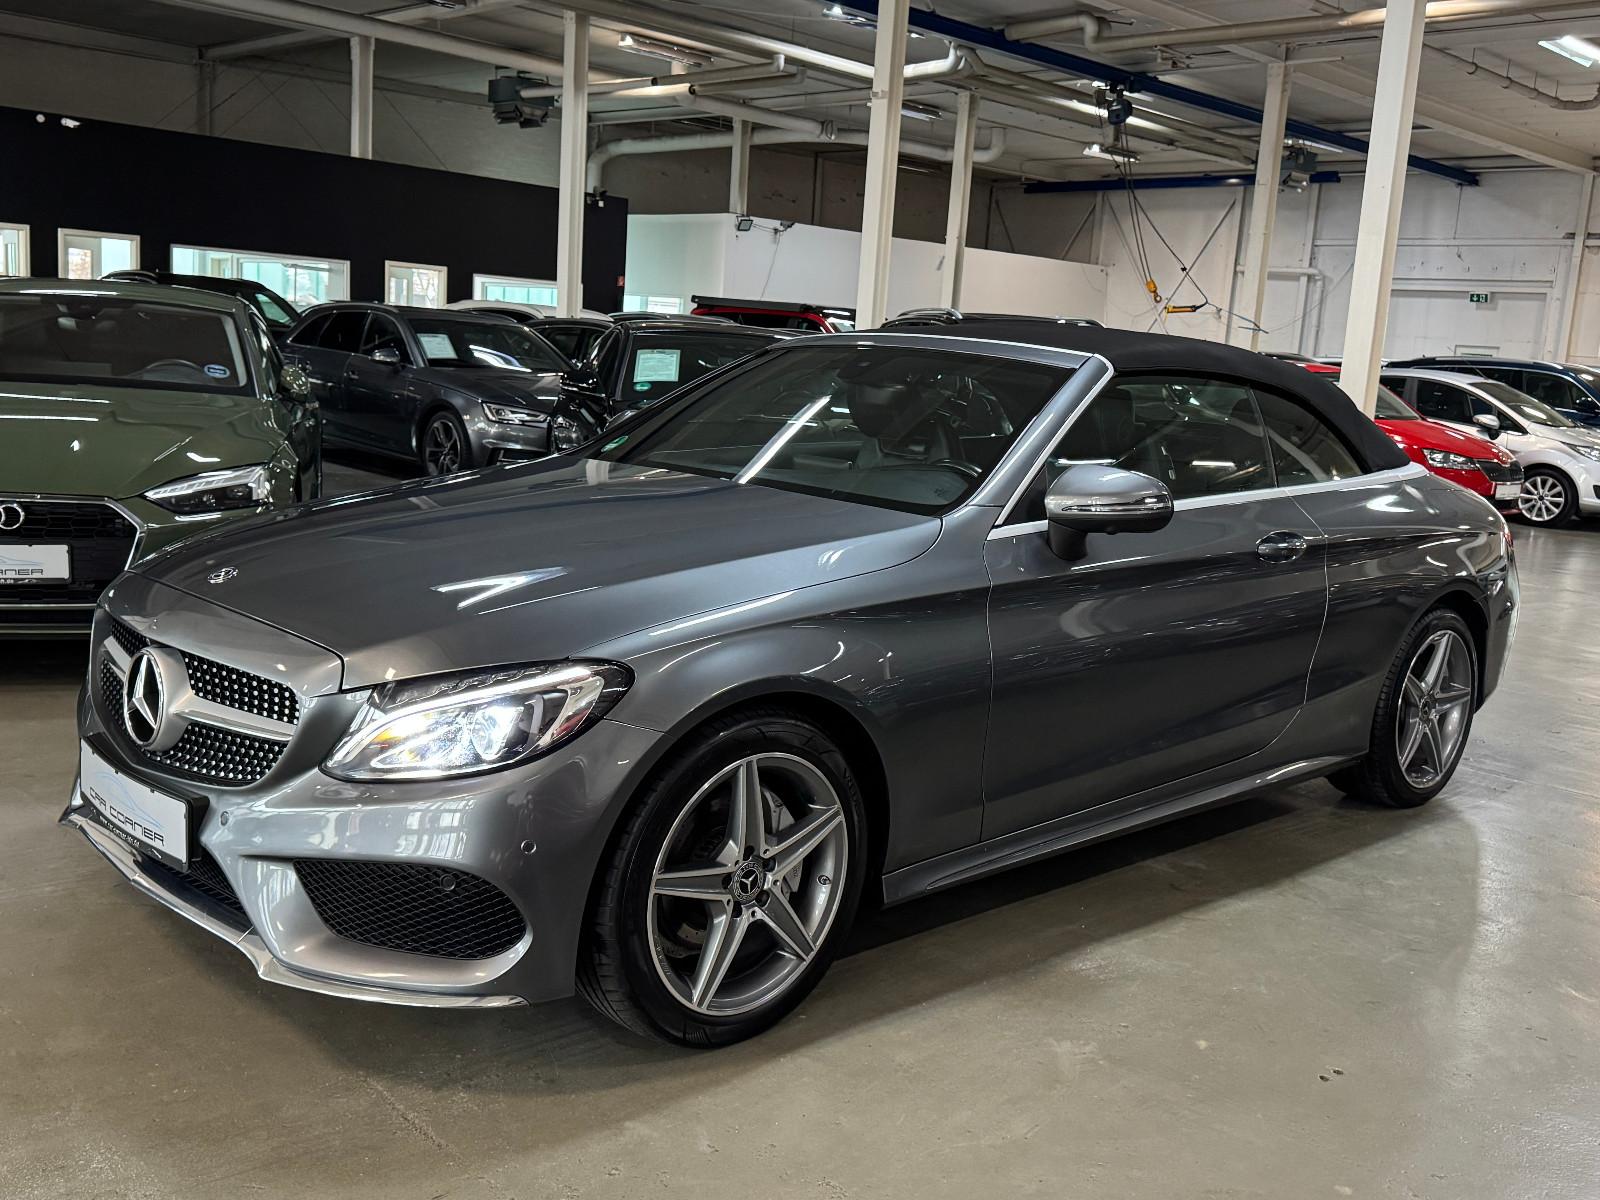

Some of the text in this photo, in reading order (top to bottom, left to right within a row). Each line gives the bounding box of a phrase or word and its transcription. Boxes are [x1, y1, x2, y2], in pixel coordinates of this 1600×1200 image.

[0, 568, 44, 576] NER
[89, 786, 107, 811] CAR
[109, 805, 165, 847] CORNER
